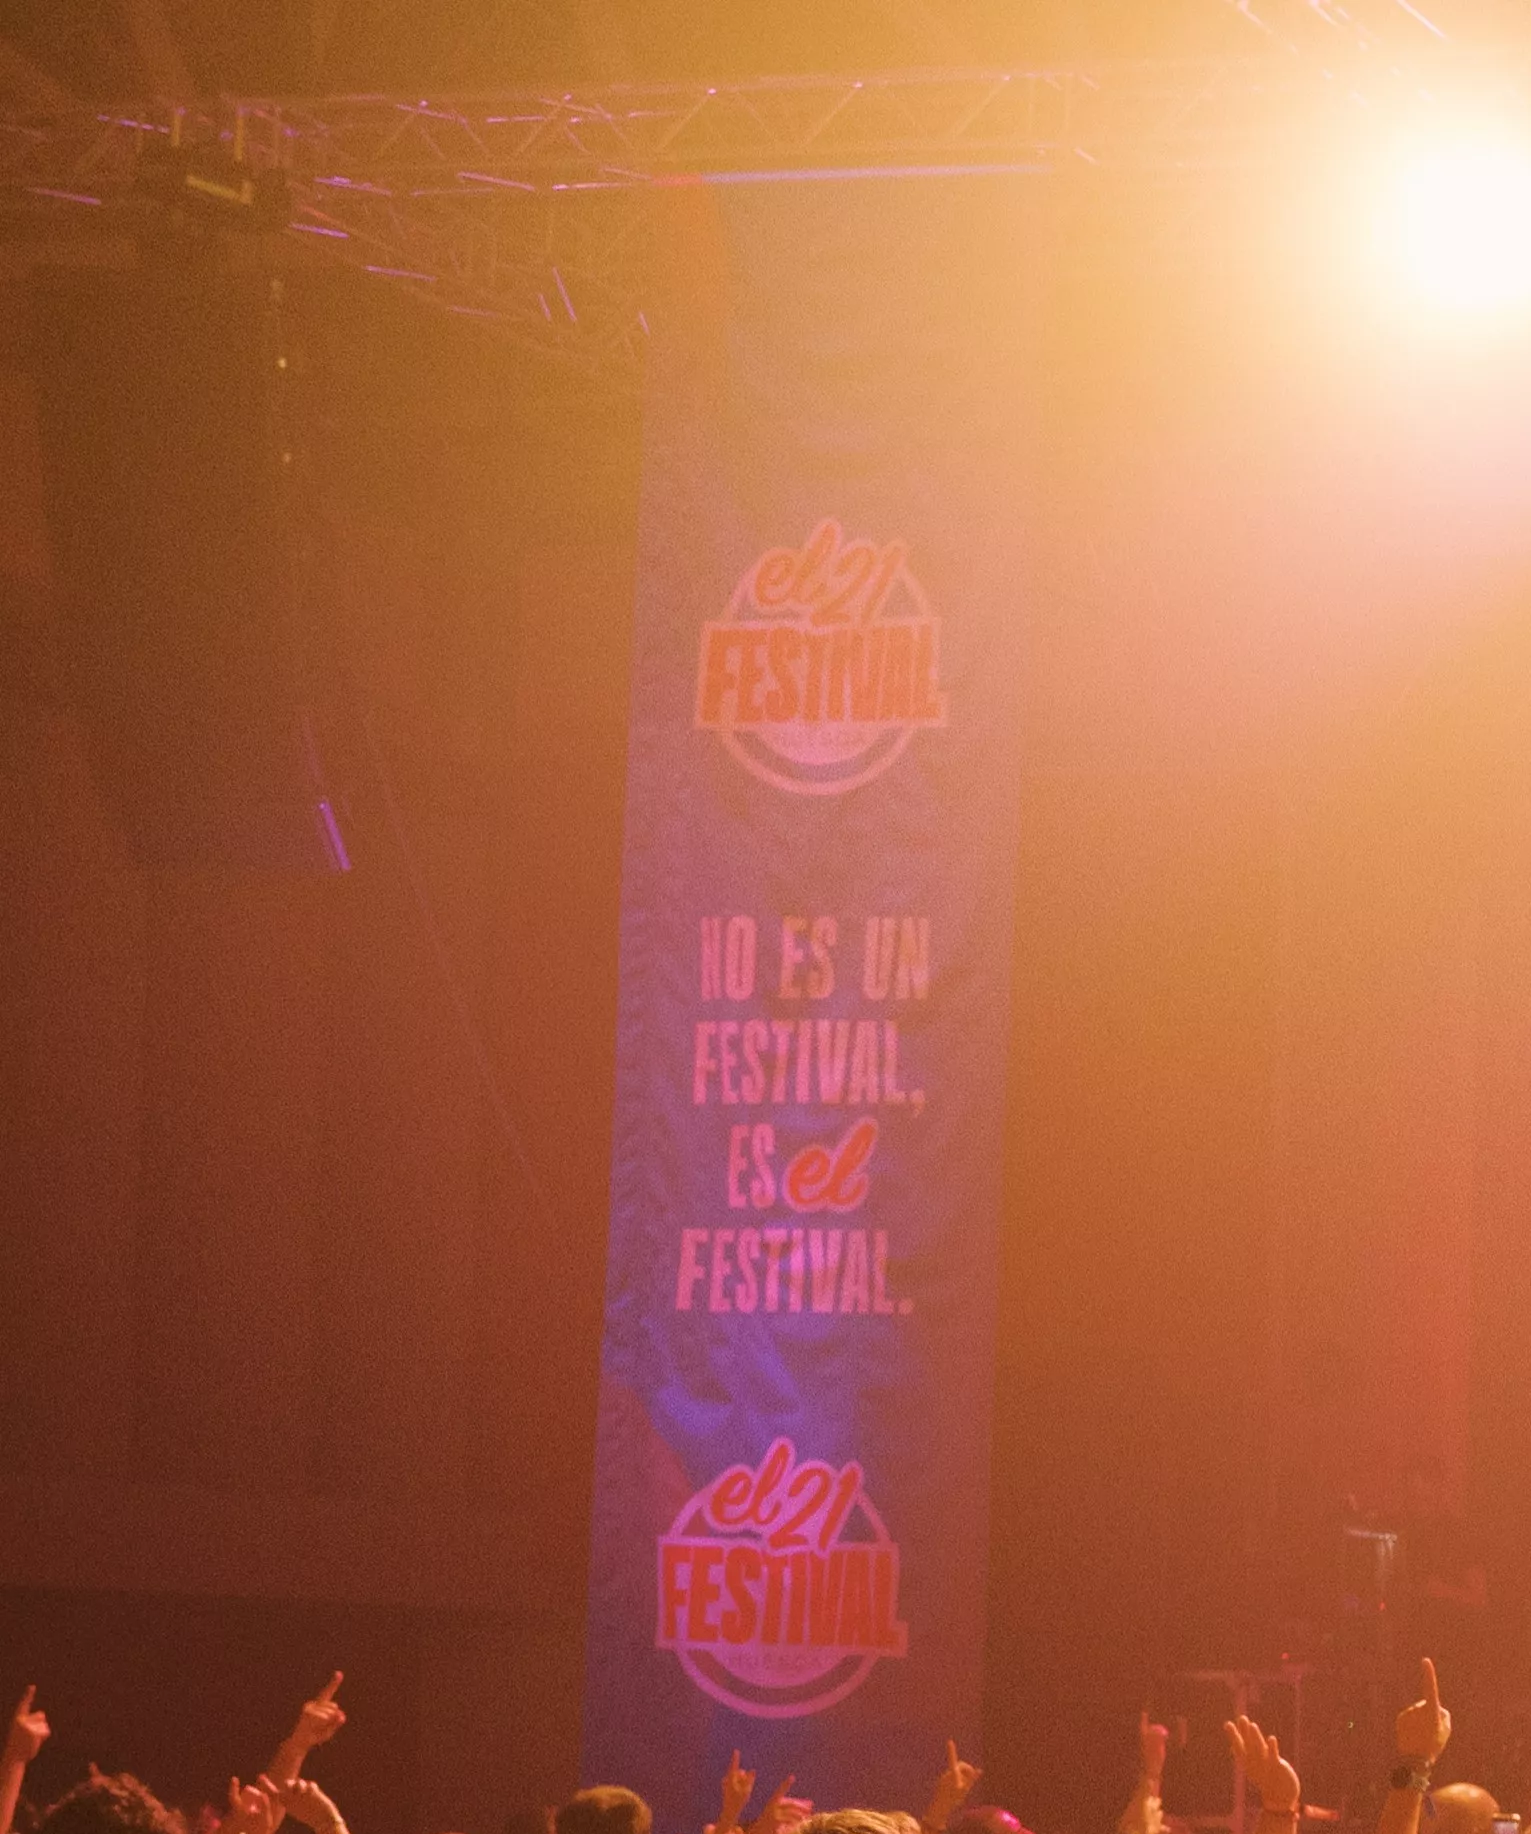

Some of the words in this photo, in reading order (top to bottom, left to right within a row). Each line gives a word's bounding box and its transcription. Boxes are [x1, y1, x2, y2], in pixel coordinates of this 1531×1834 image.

[699, 625, 945, 724] FESTIVAL
[701, 916, 757, 1000] NO
[780, 916, 837, 1000] ES
[863, 916, 931, 1000] UN
[693, 1020, 927, 1116] FESTIVAL,
[727, 1123, 776, 1209] ES
[786, 1120, 877, 1211] el
[675, 1227, 917, 1316] FESTIVAL.
[661, 1545, 903, 1648] FESTIVAL
